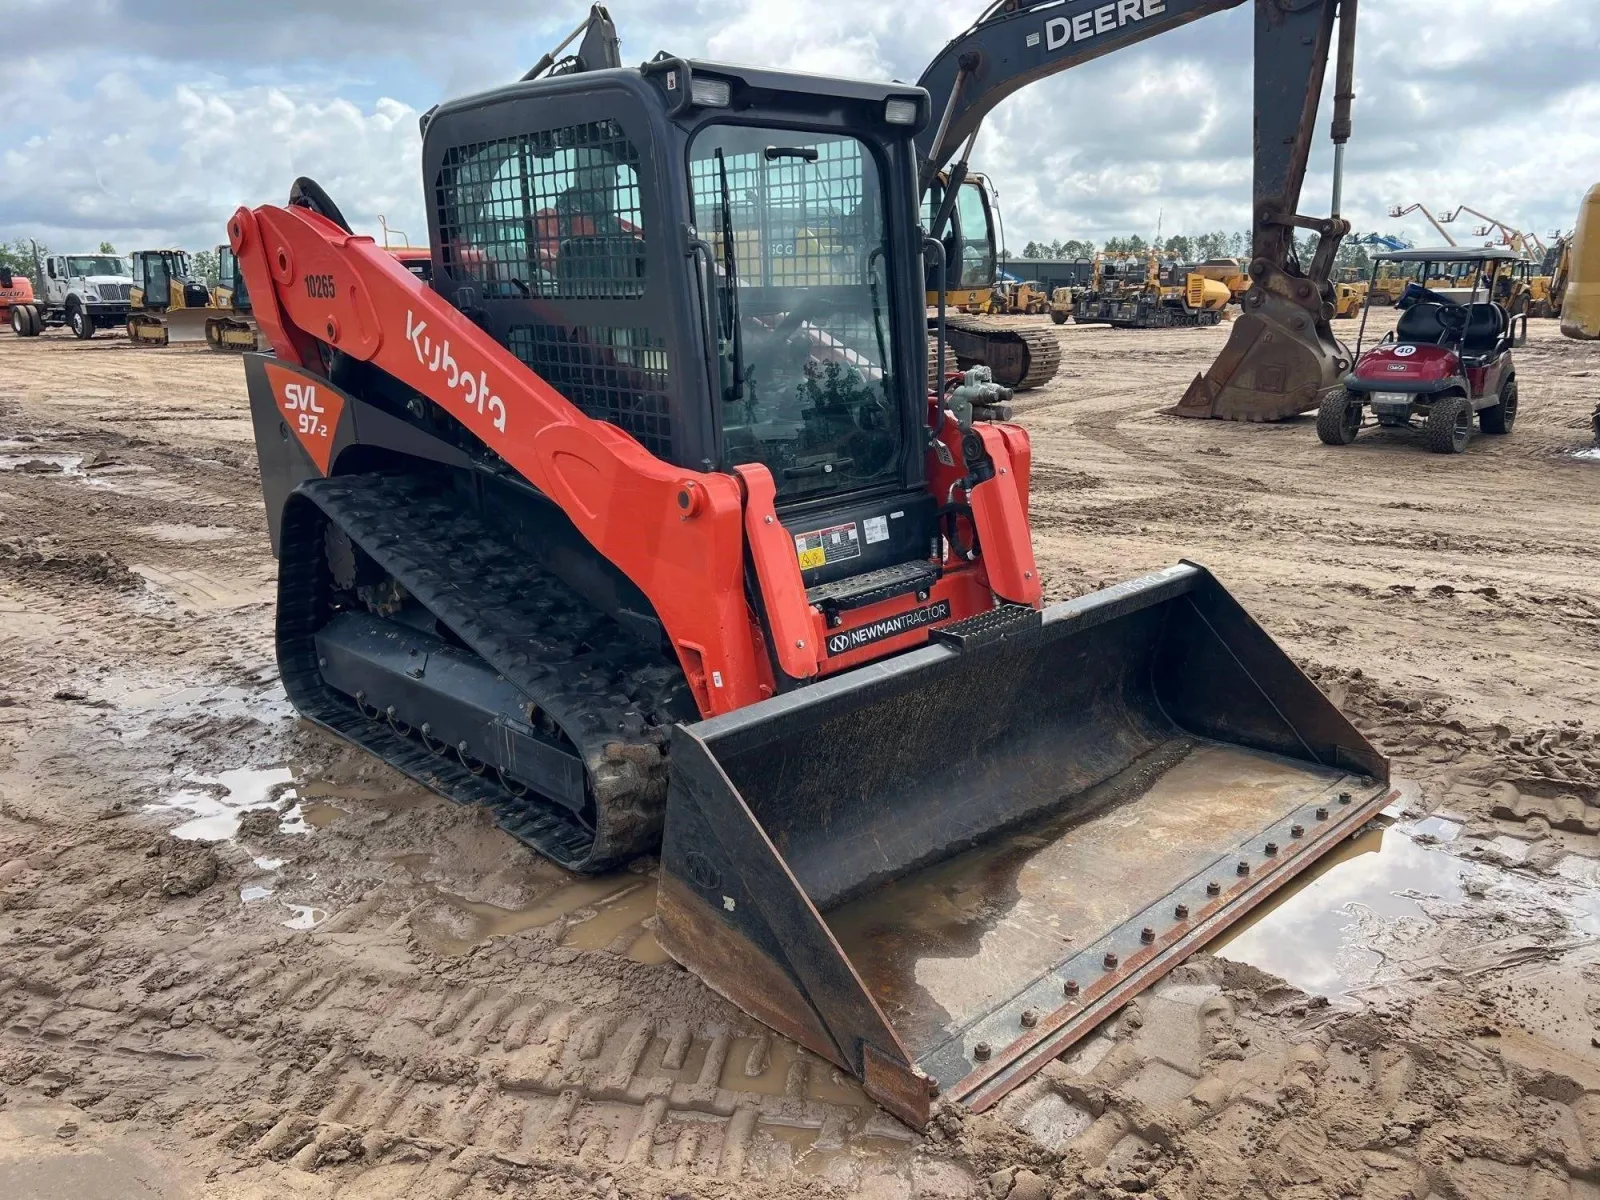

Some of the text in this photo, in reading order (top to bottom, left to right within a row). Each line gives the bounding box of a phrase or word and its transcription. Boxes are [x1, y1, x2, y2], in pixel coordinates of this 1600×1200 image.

[1045, 0, 1166, 51] DEERE
[304, 274, 336, 299] 10265
[406, 309, 506, 433] Kubota
[284, 383, 325, 413] SVL
[298, 413, 328, 437] 97-2
